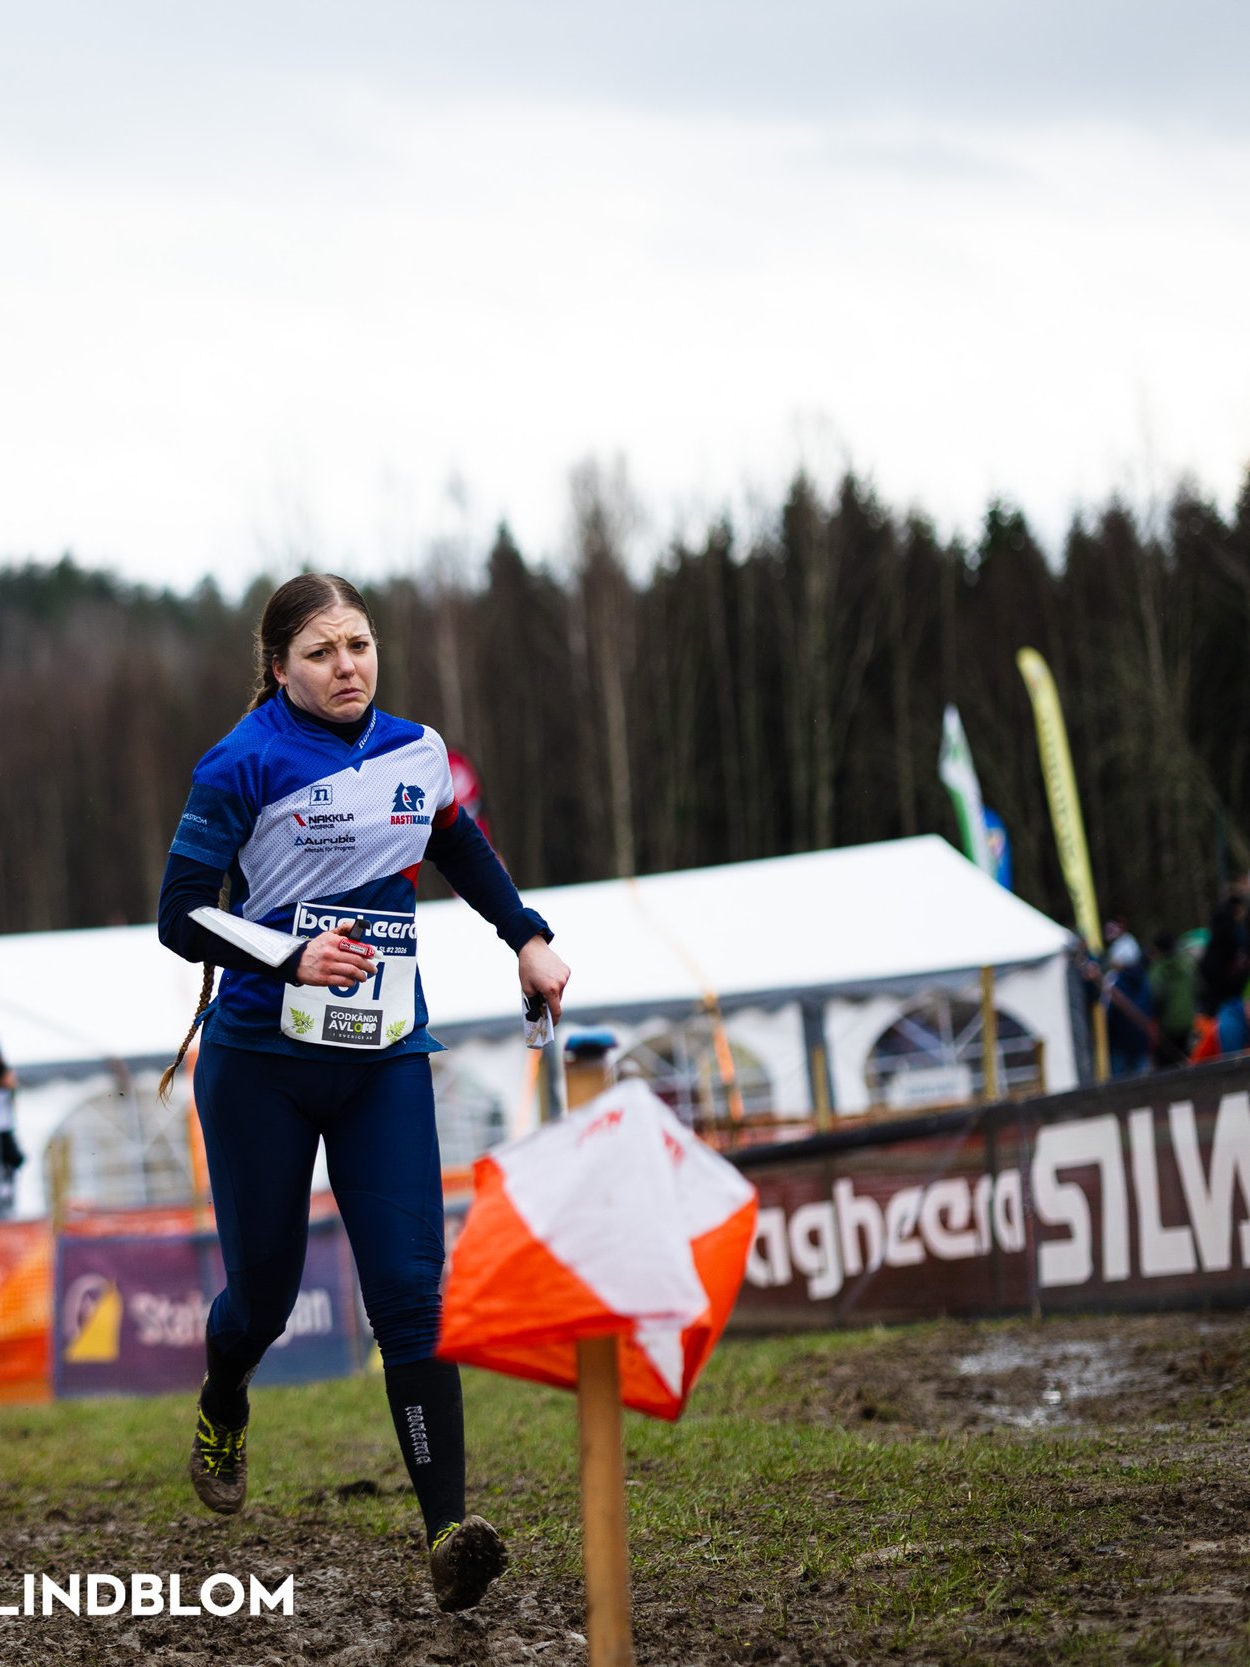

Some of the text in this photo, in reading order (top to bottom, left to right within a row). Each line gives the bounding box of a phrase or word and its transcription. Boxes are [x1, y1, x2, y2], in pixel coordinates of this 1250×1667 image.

[308, 813, 355, 824] NAKKILA
[304, 834, 356, 846] Aurubis
[328, 1019, 377, 1034] AVLOPP
[746, 1168, 1027, 1300] agheera
